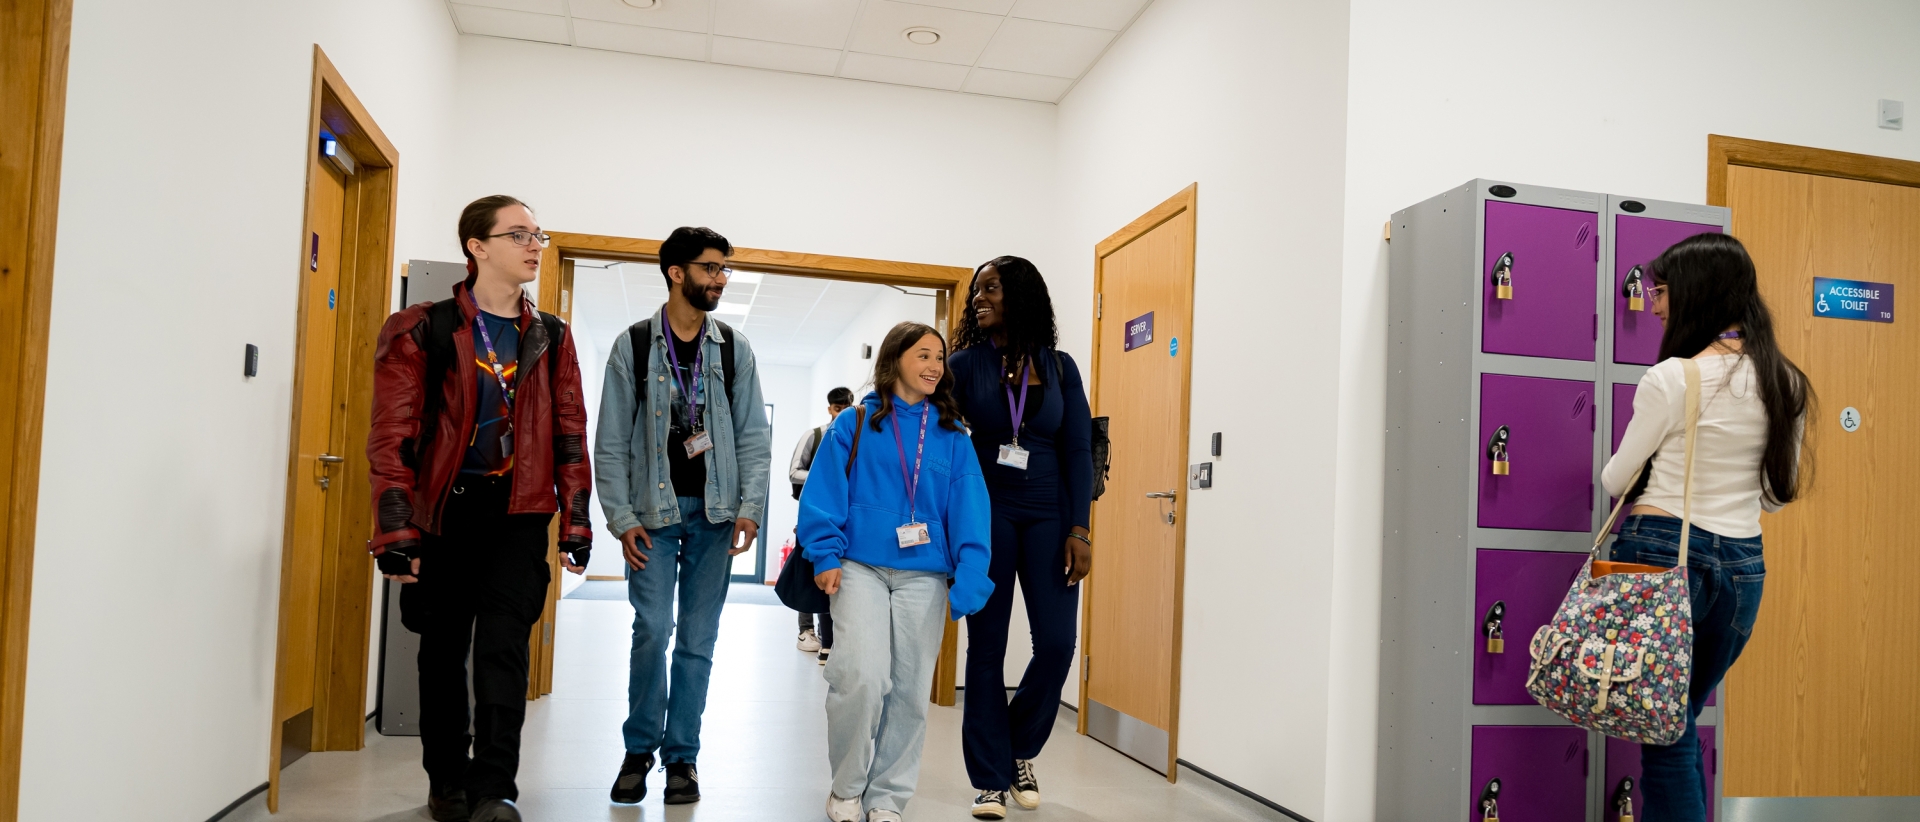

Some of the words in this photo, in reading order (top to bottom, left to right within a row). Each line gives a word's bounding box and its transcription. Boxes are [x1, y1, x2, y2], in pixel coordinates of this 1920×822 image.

[1829, 286, 1880, 300] ACCESSIBLE
[1840, 299, 1869, 311] TOILET
[1880, 311, 1891, 319] T10
[1130, 321, 1147, 336] SERVER
